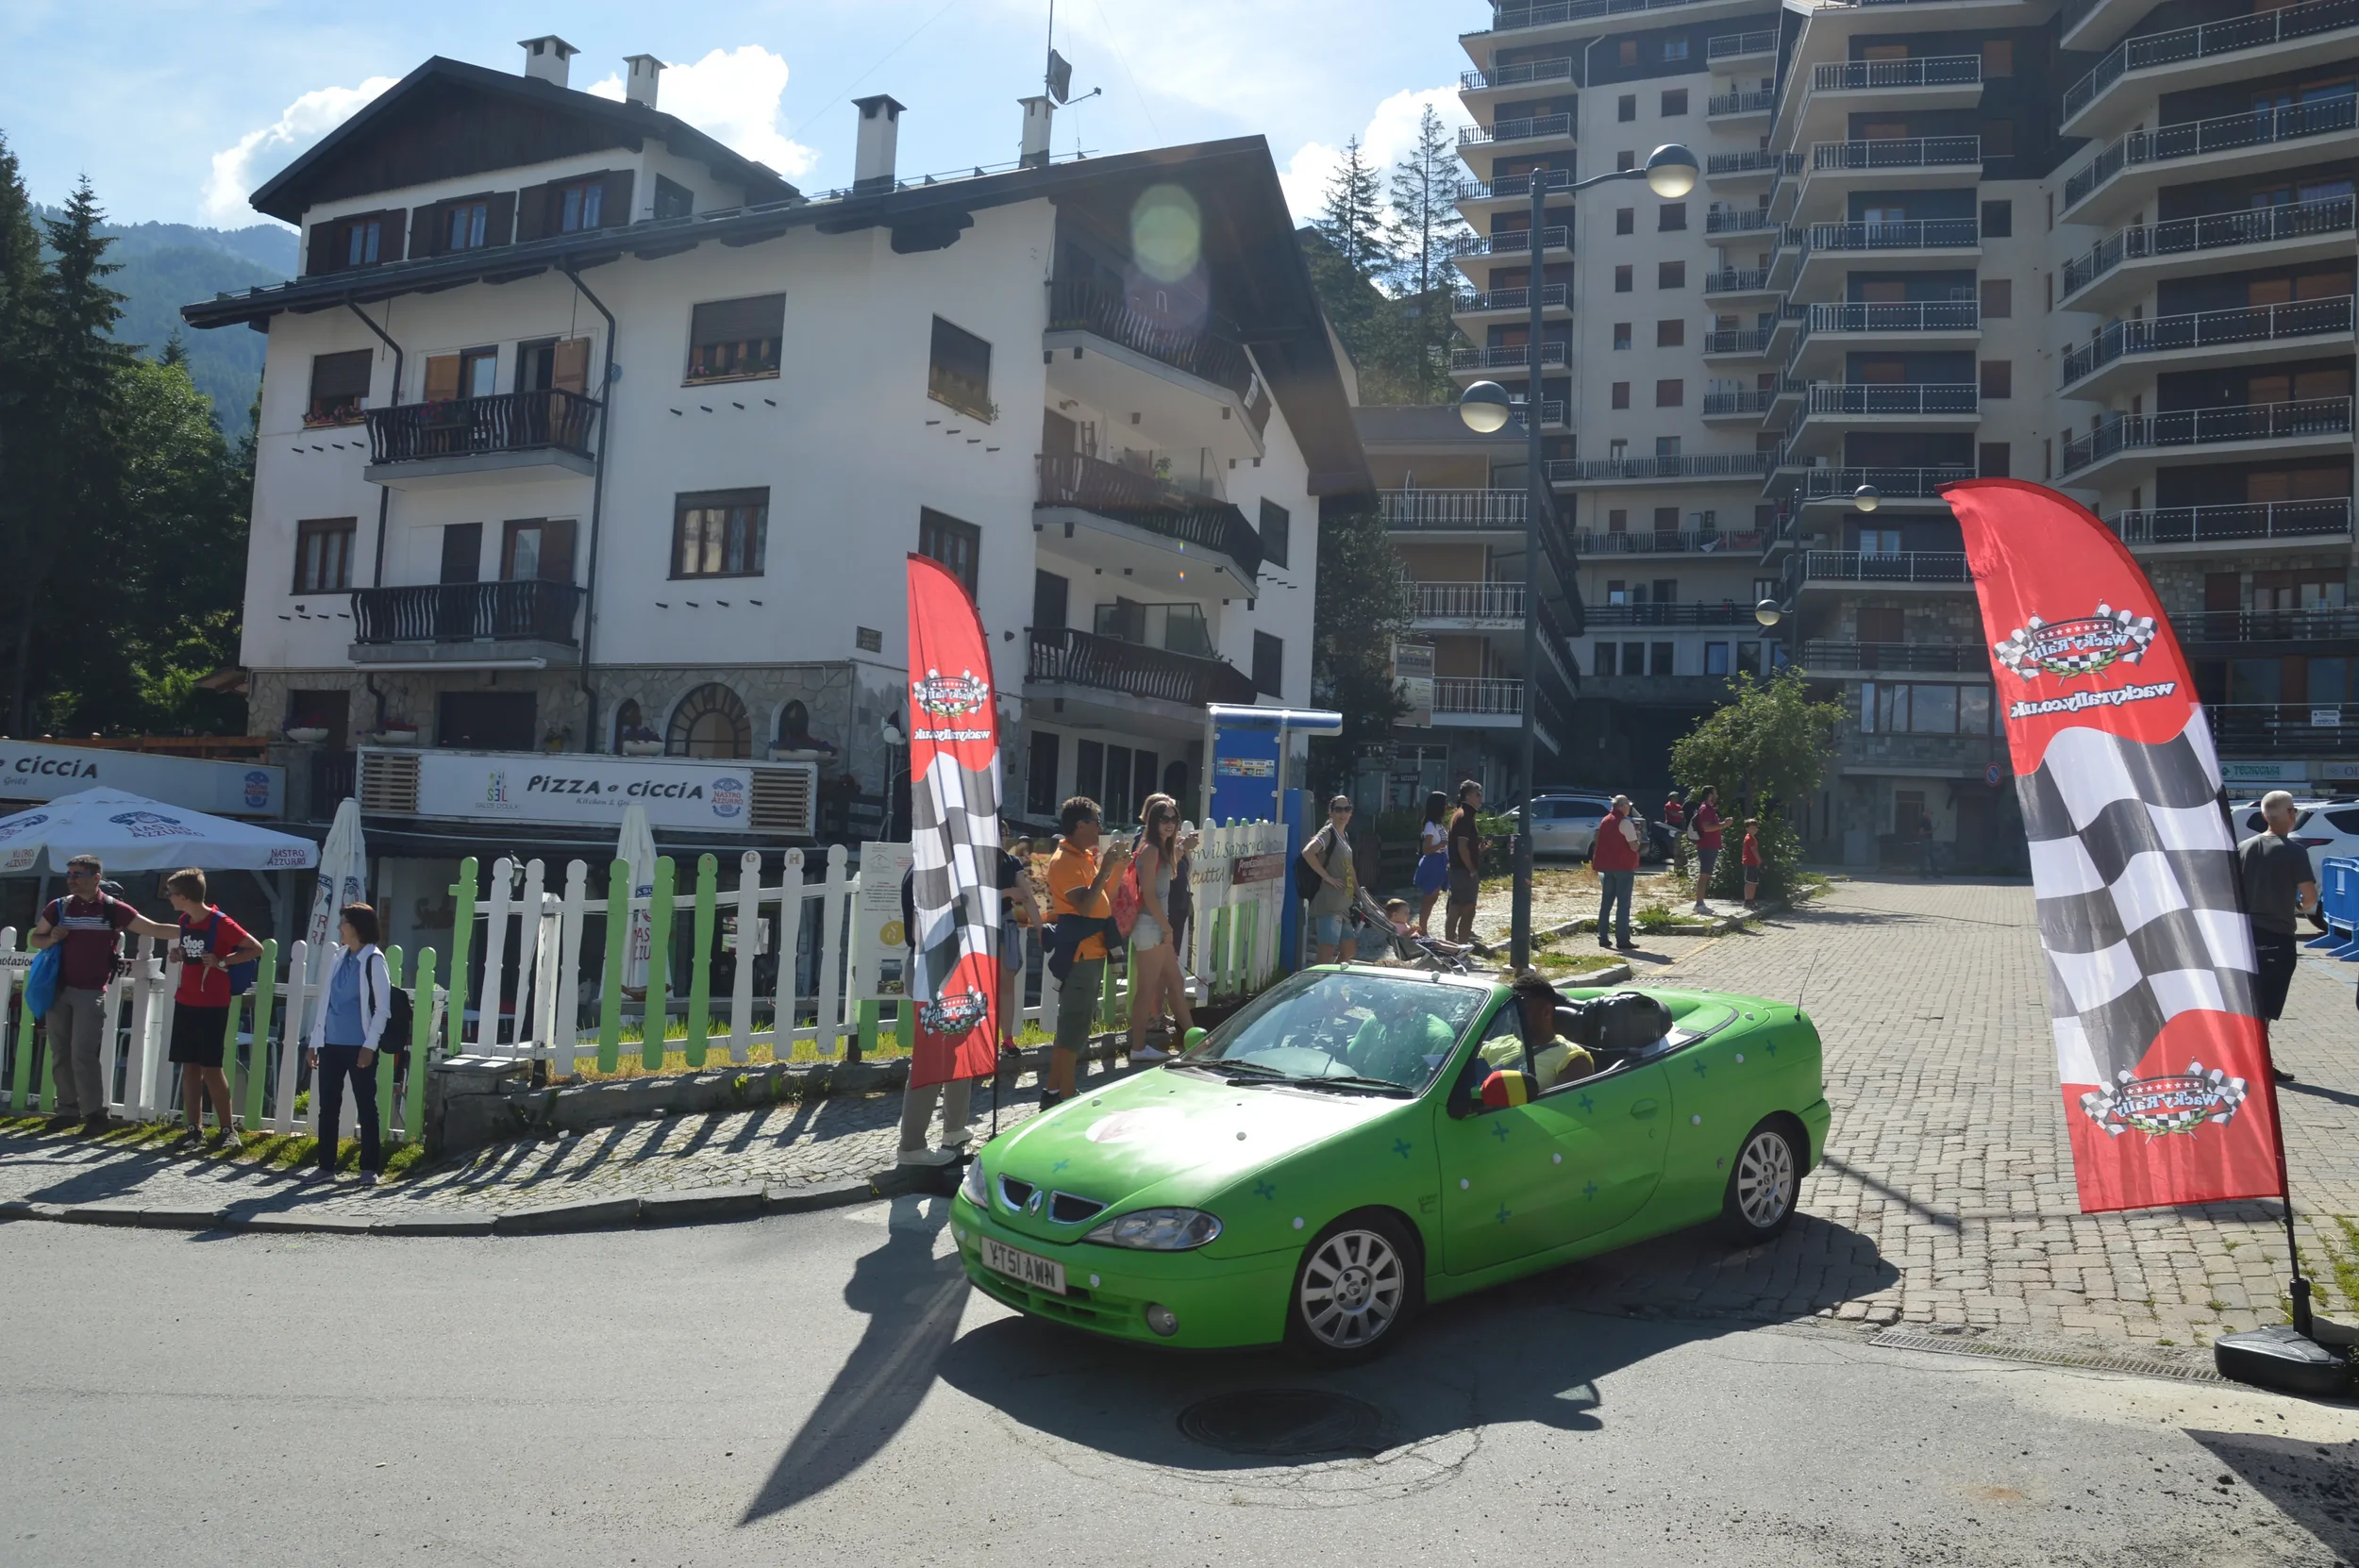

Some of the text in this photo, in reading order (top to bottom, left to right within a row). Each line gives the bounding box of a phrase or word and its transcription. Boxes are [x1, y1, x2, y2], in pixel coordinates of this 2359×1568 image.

[2234, 765, 2281, 776] TECNOCASA
[713, 791, 741, 799] NASTRO
[267, 858, 306, 866] AZZURRO
[788, 853, 801, 864] H
[181, 935, 205, 949] Shoe
[989, 1242, 1056, 1288] YT51 AWN
